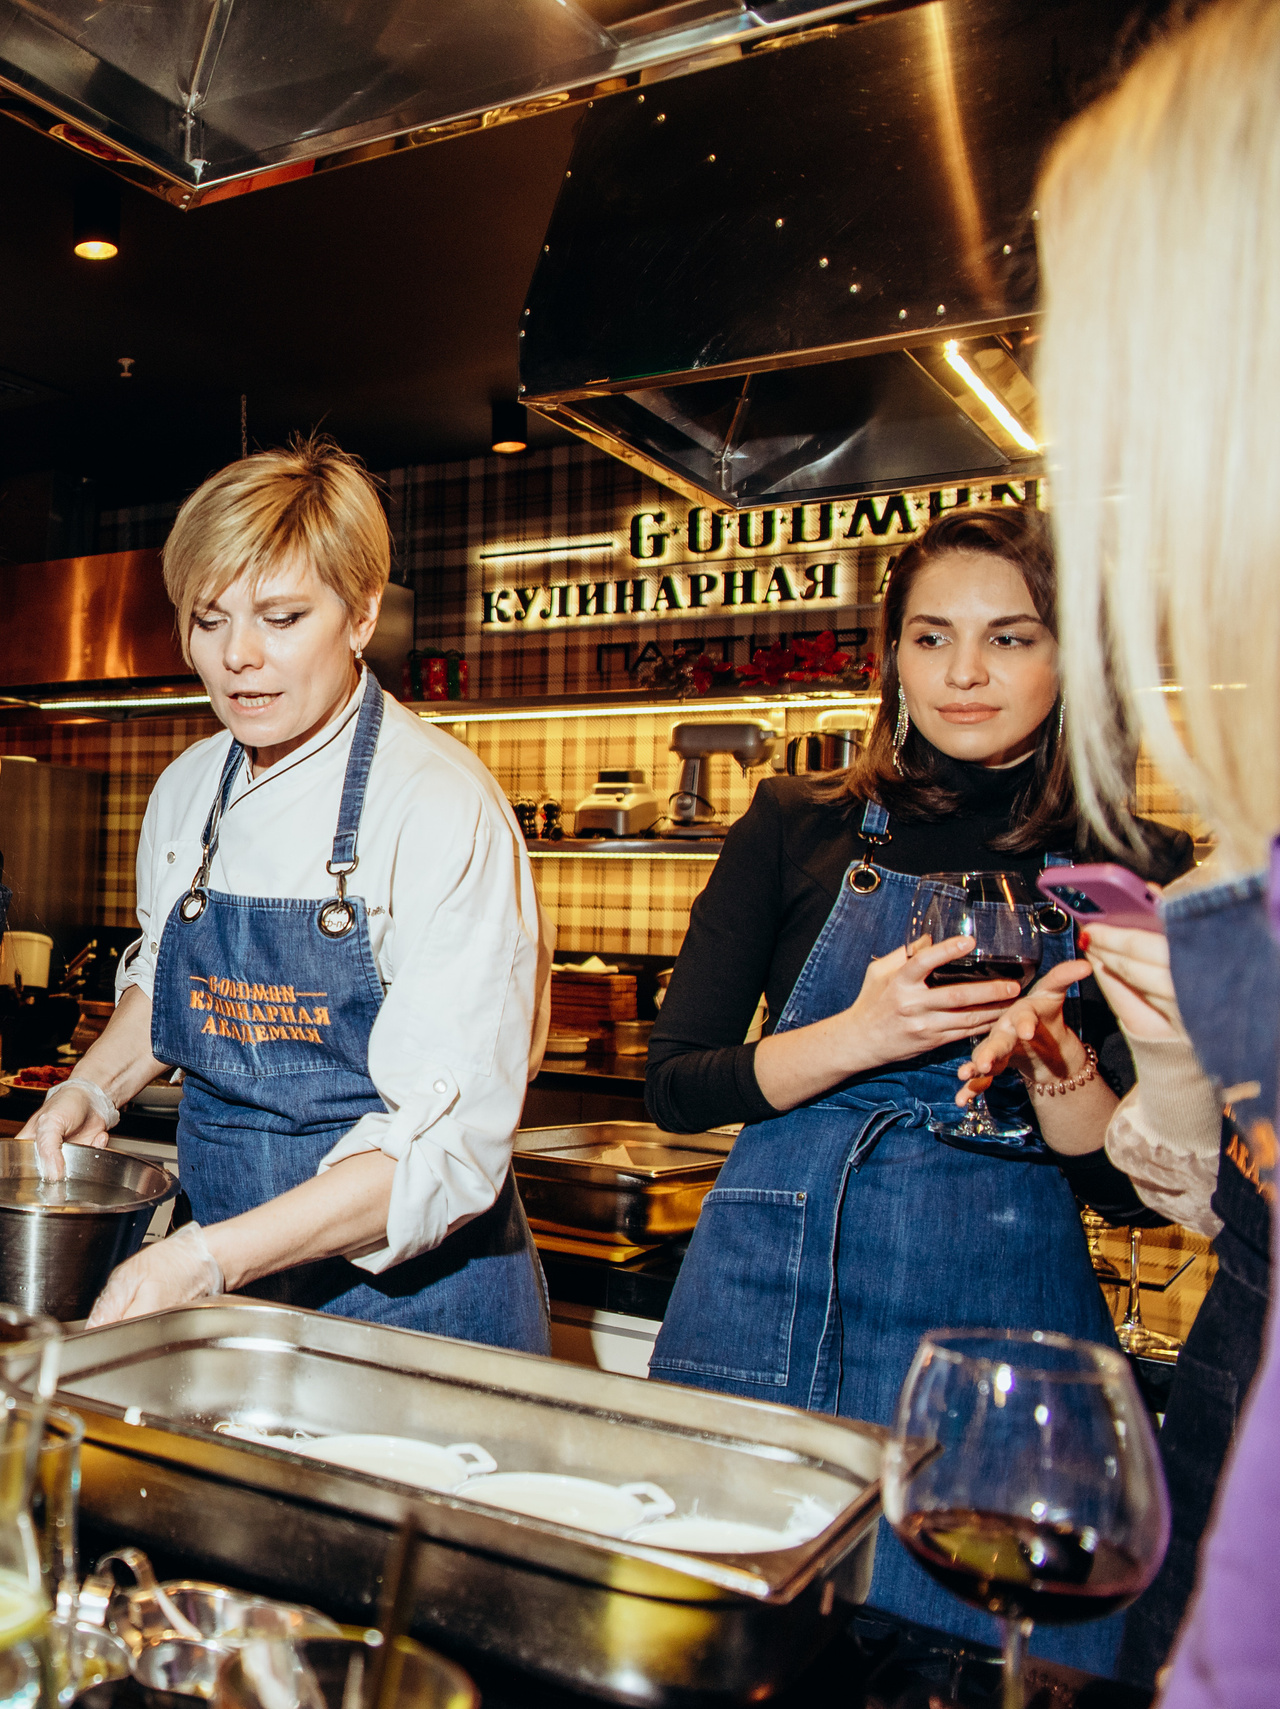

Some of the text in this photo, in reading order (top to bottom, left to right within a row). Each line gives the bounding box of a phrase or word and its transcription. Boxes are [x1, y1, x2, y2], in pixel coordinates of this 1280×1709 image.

[482, 562, 841, 625] КУЛИНАРНАЯ
[189, 990, 332, 1026] КУЛИНАРНАЯ
[201, 1015, 324, 1046] АКАДЕМИЯ
